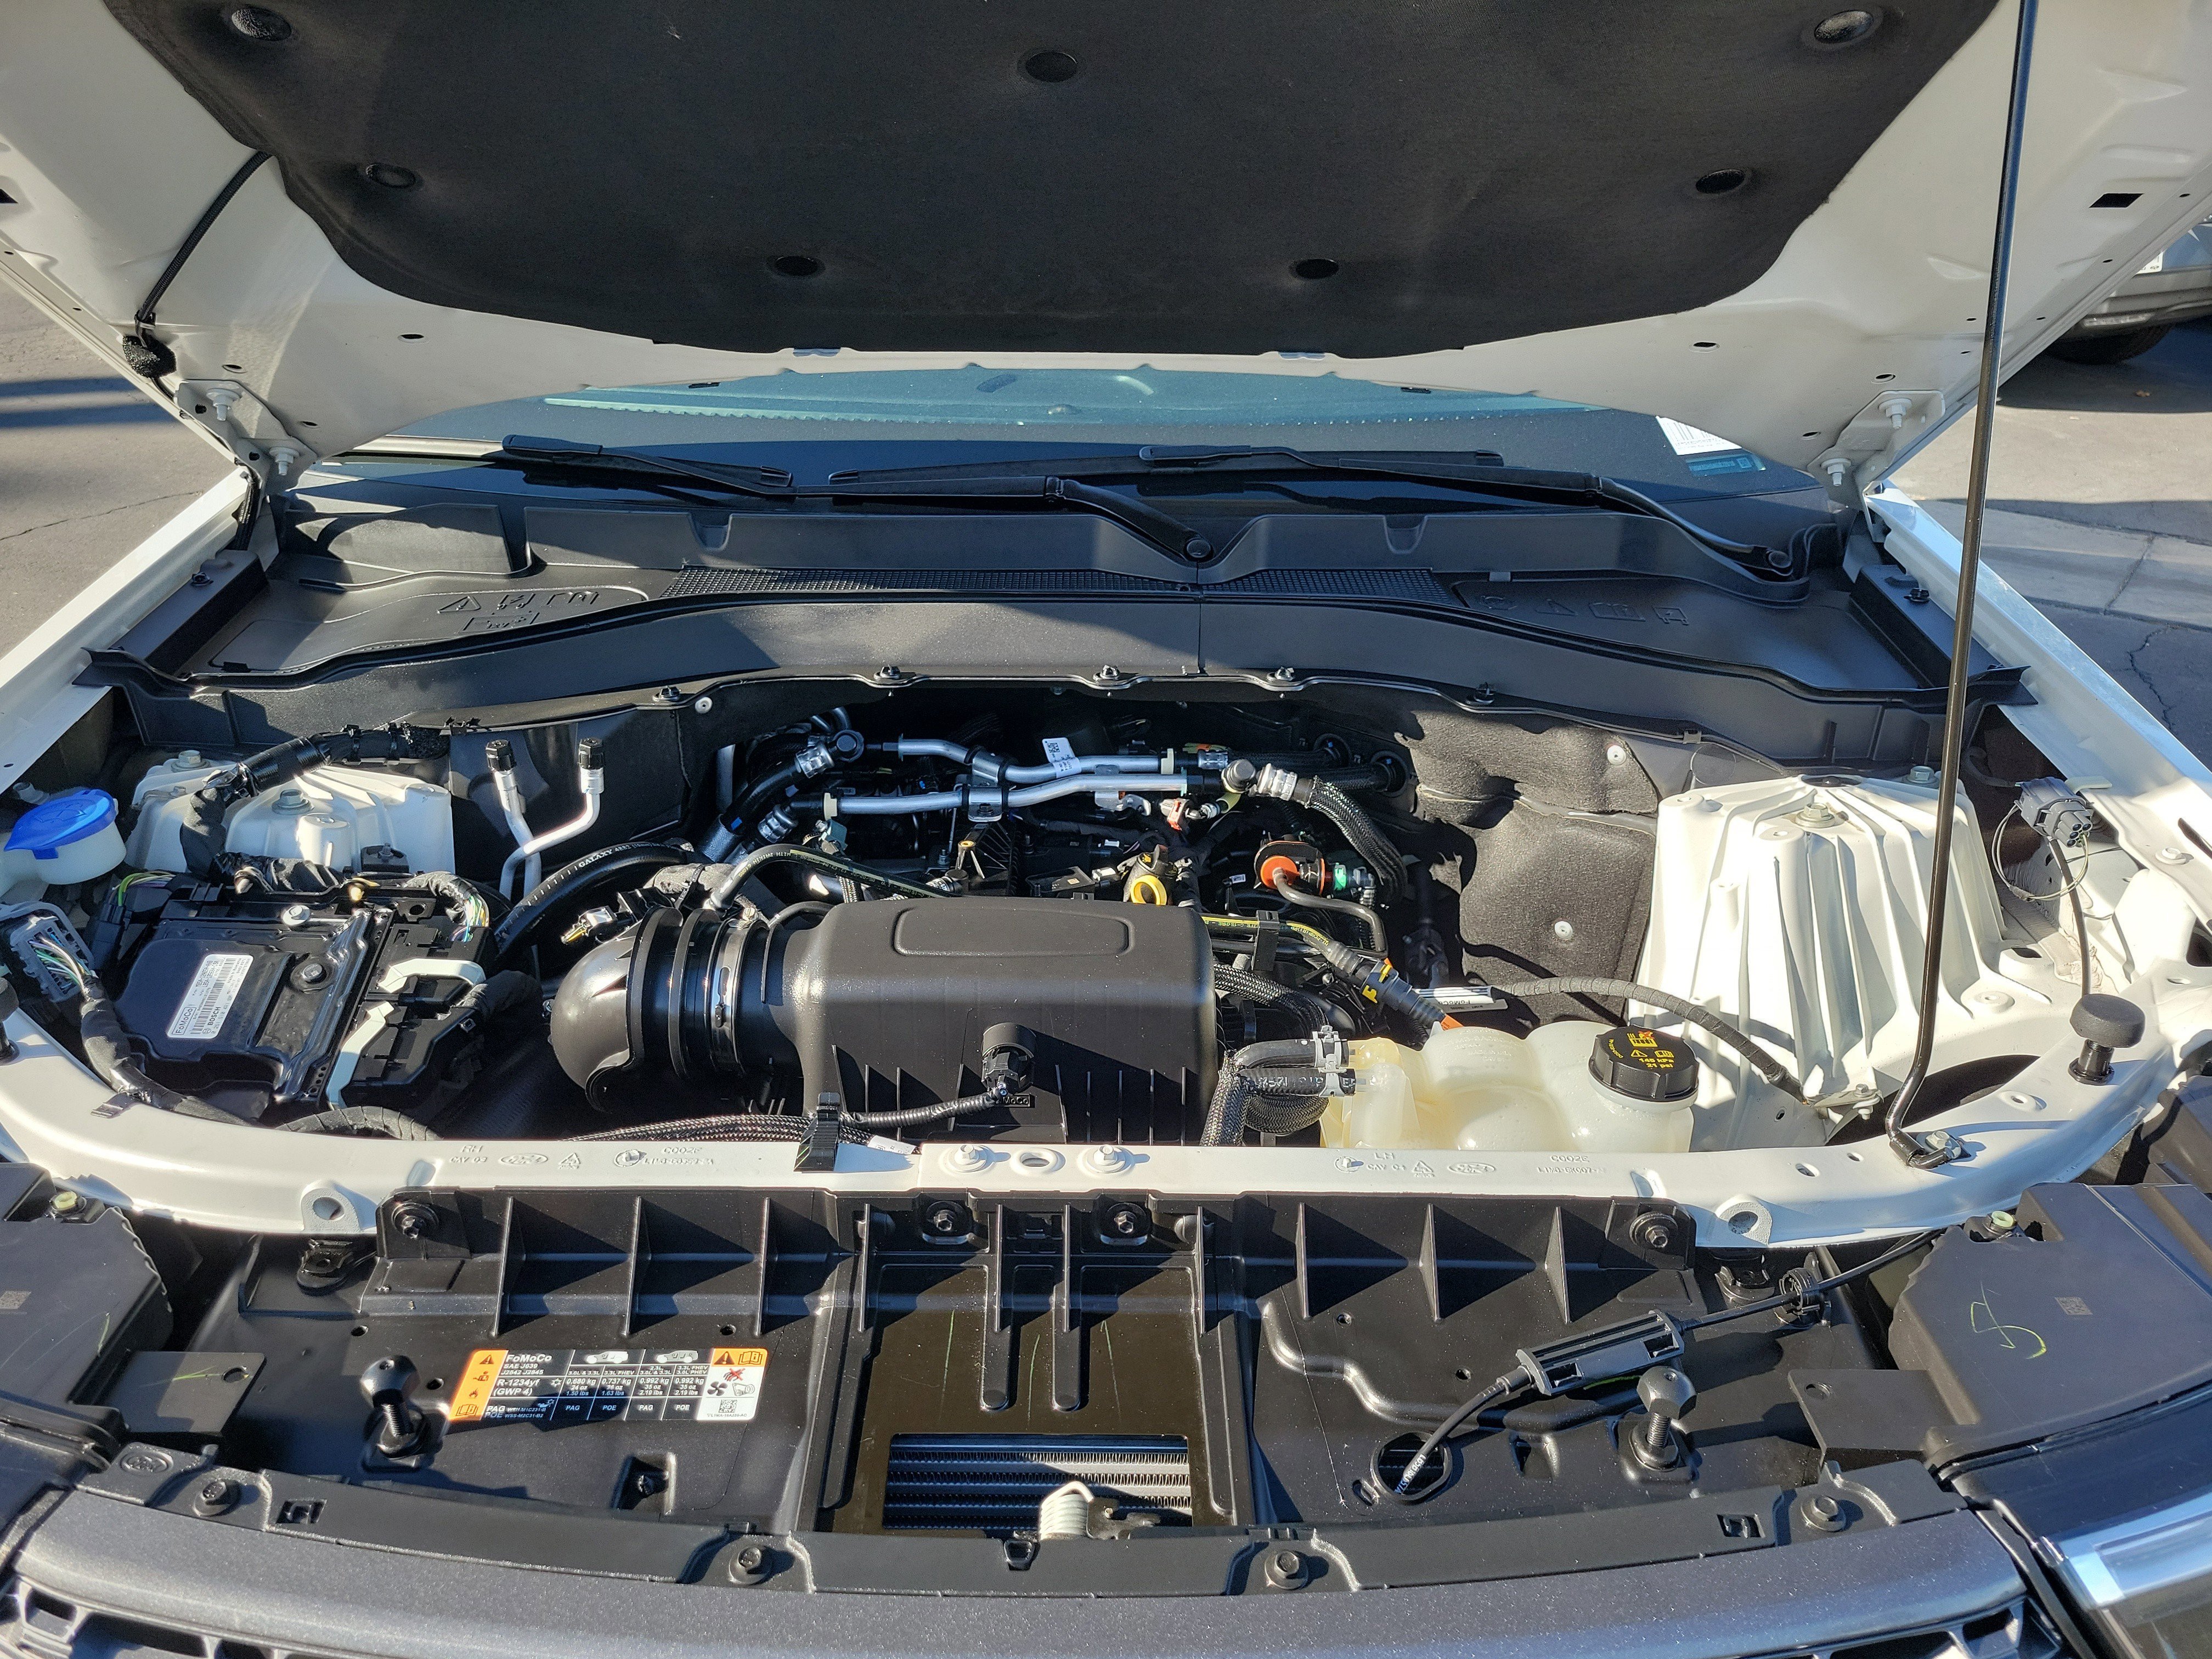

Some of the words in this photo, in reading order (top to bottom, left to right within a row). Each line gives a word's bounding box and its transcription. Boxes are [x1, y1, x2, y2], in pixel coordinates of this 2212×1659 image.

[578, 849, 613, 868] GALAXY
[176, 1008, 194, 1034] FoMoCo
[208, 1007, 221, 1026] BOSCH
[461, 1144, 483, 1153] RH
[505, 1353, 552, 1362] FoMoCo
[496, 1378, 541, 1387] R-1234yf
[587, 1378, 597, 1386] kg
[622, 1378, 632, 1386] kg
[660, 1377, 670, 1385] kg
[695, 1377, 705, 1385] kg
[493, 1387, 522, 1396] (GWP
[522, 1387, 533, 1397] 4)
